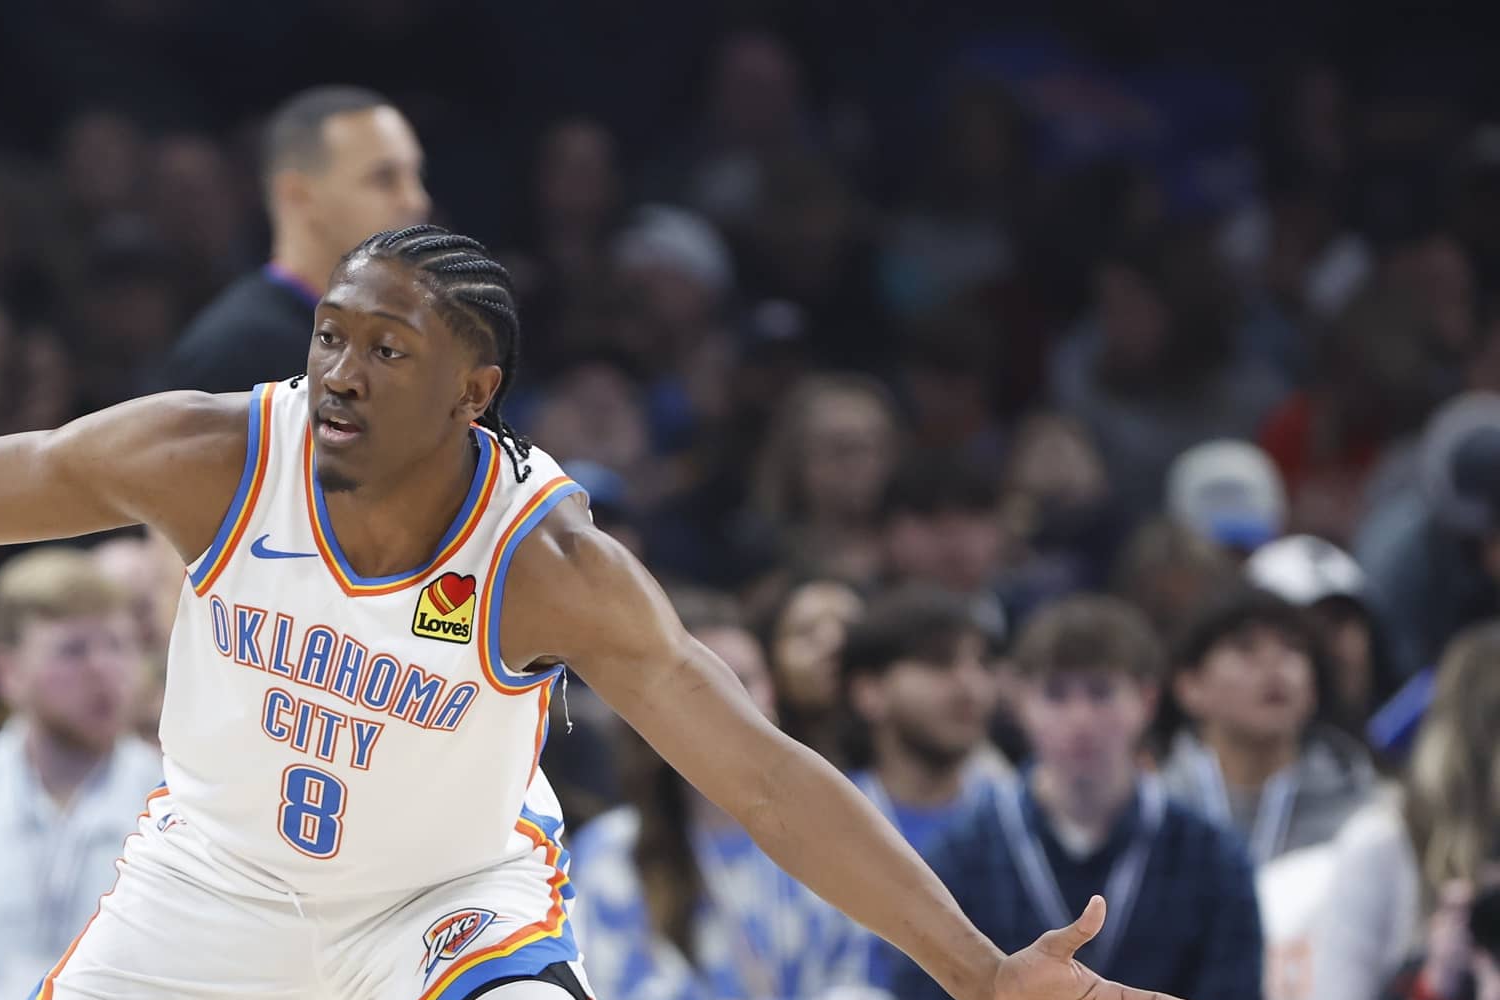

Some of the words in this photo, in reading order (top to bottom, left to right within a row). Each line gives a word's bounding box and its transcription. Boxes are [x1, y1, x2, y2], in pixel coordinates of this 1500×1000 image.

[210, 595, 479, 732] OKLAHOMA
[262, 687, 384, 770] CITY
[277, 763, 348, 860] 8
